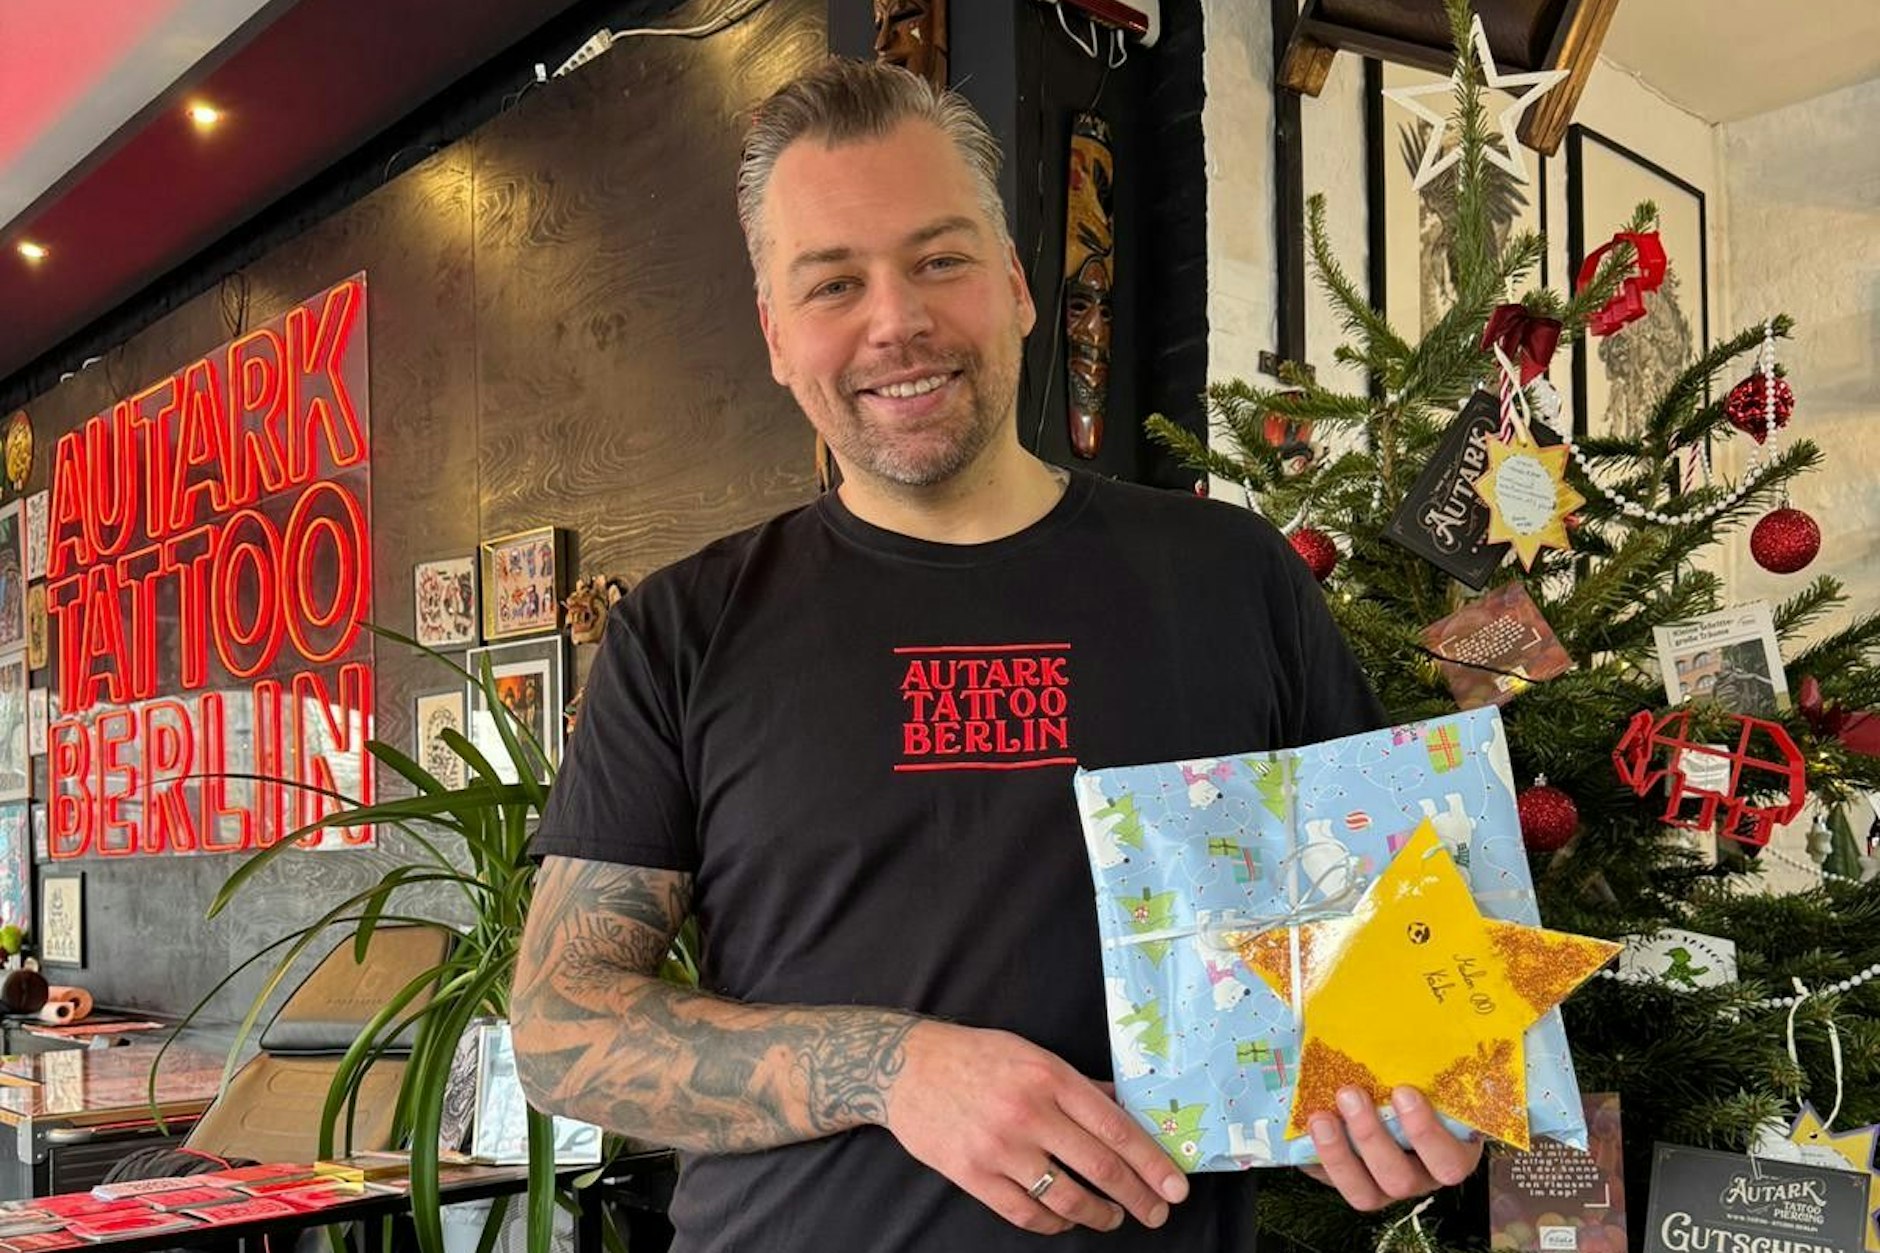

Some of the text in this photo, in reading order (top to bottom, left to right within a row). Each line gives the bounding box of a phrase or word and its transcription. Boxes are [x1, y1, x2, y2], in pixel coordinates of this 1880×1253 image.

[47, 280, 364, 577] AUTARK
[1424, 427, 1488, 546] AUTARK
[47, 479, 366, 714] TATTOO
[902, 658, 1069, 689] AUTARK
[903, 687, 1067, 721] TATTOO
[903, 718, 1068, 754] BERLIN
[48, 663, 371, 859] BERLIN
[1548, 1189, 1578, 1198] Kopf
[1726, 1176, 1827, 1206] AUTARK
[1784, 1200, 1822, 1216] TATTOO
[1774, 1207, 1825, 1225] PIERCING
